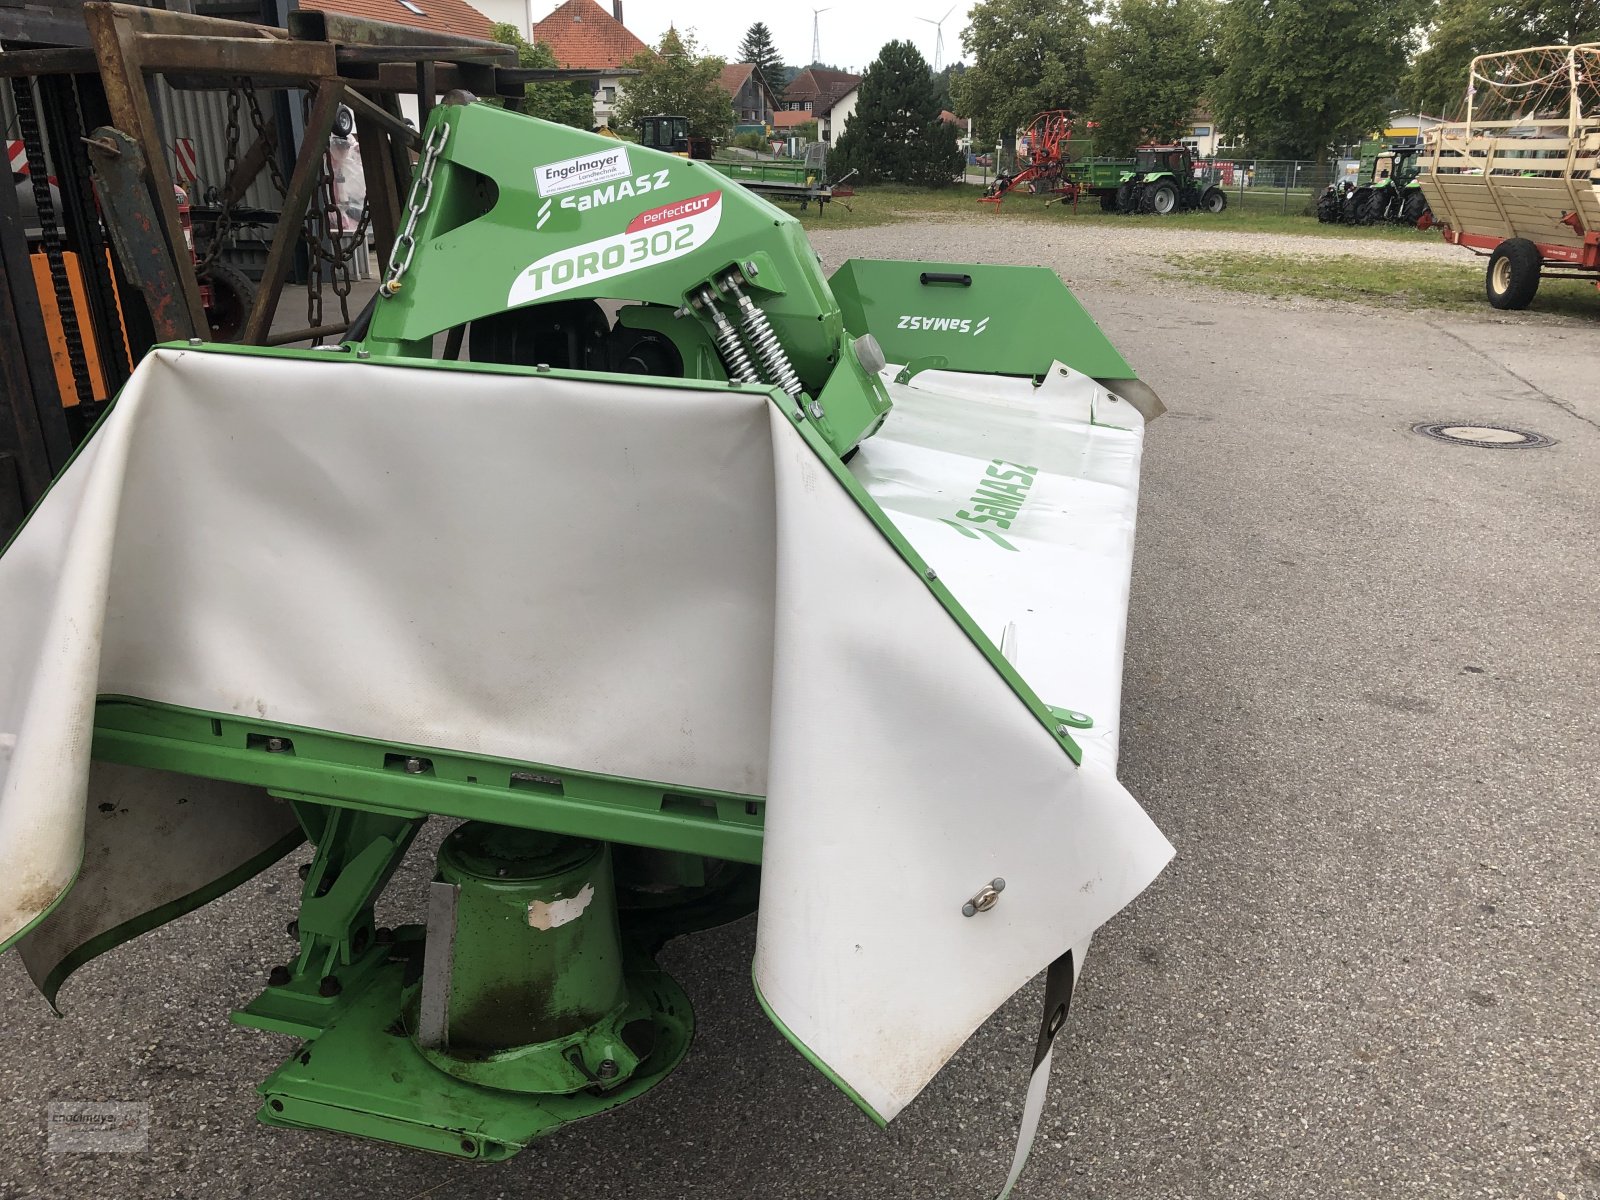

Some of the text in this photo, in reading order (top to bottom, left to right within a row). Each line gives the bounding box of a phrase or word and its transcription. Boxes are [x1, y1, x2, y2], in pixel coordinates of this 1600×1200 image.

[545, 155, 619, 180] Engelmayer
[578, 166, 617, 181] Landtechnik
[560, 169, 670, 212] SaMASZ
